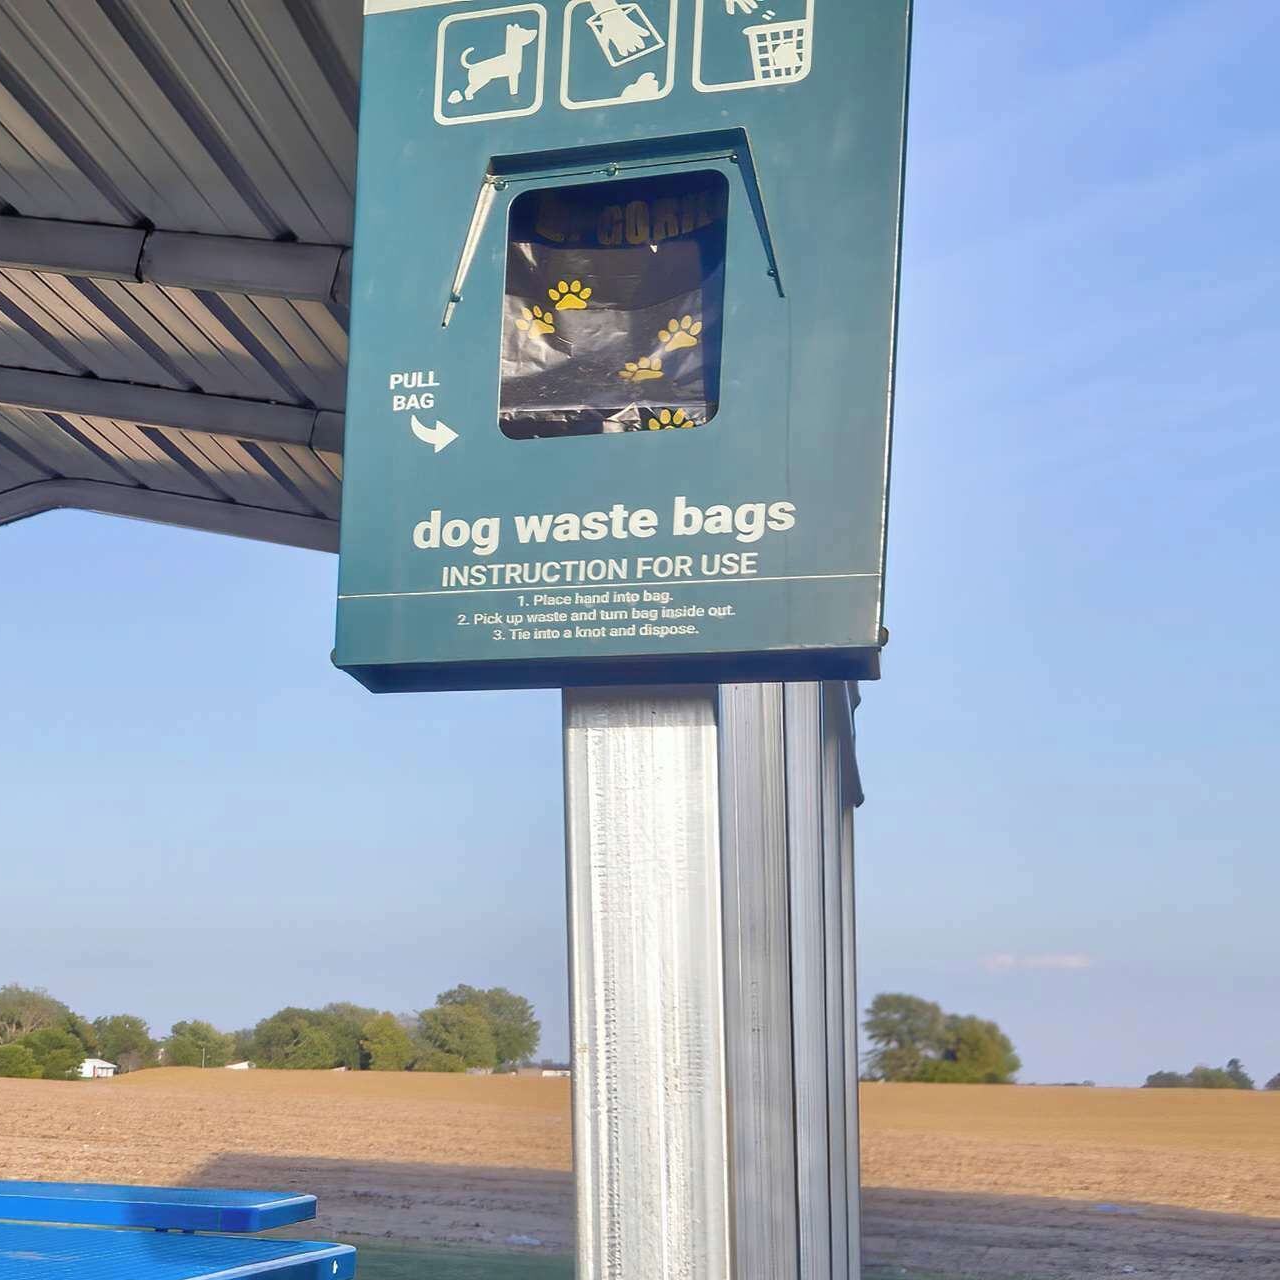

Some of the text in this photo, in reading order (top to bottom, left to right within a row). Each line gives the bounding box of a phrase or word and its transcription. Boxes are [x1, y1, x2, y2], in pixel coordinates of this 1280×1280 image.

[389, 371, 440, 389] PULL
[392, 393, 434, 411] BAG
[413, 496, 796, 556] dog waste bags
[441, 552, 758, 587] INSTRUCTION FOR USE
[516, 589, 674, 607] 1. Place hand into bag.
[473, 612, 503, 625] Pick
[506, 614, 523, 626] up
[527, 611, 568, 623] waste
[570, 608, 597, 621] and
[600, 609, 628, 621] turn
[631, 607, 658, 621] bag
[661, 605, 705, 618] inside
[708, 604, 736, 616] out.
[492, 623, 699, 641] 3. Tie into a knot and dispose.
